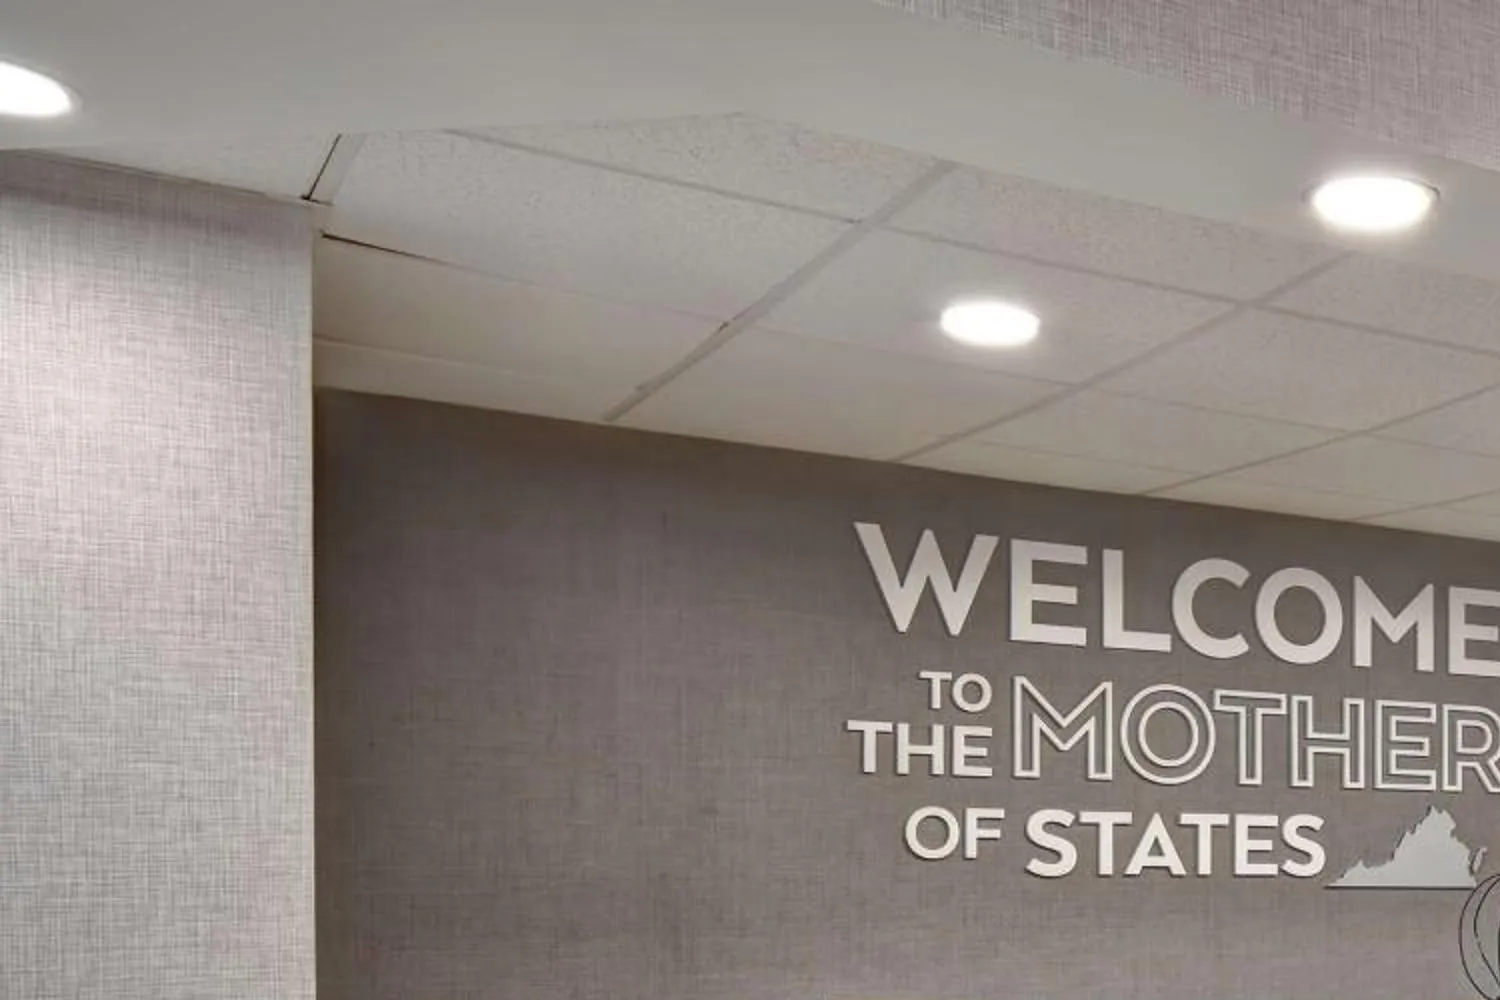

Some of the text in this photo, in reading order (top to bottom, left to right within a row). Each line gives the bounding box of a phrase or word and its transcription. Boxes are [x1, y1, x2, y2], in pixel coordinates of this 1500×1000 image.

[920, 671, 993, 713] TO
[847, 720, 993, 777] THE
[905, 806, 1326, 878] OF STATES
